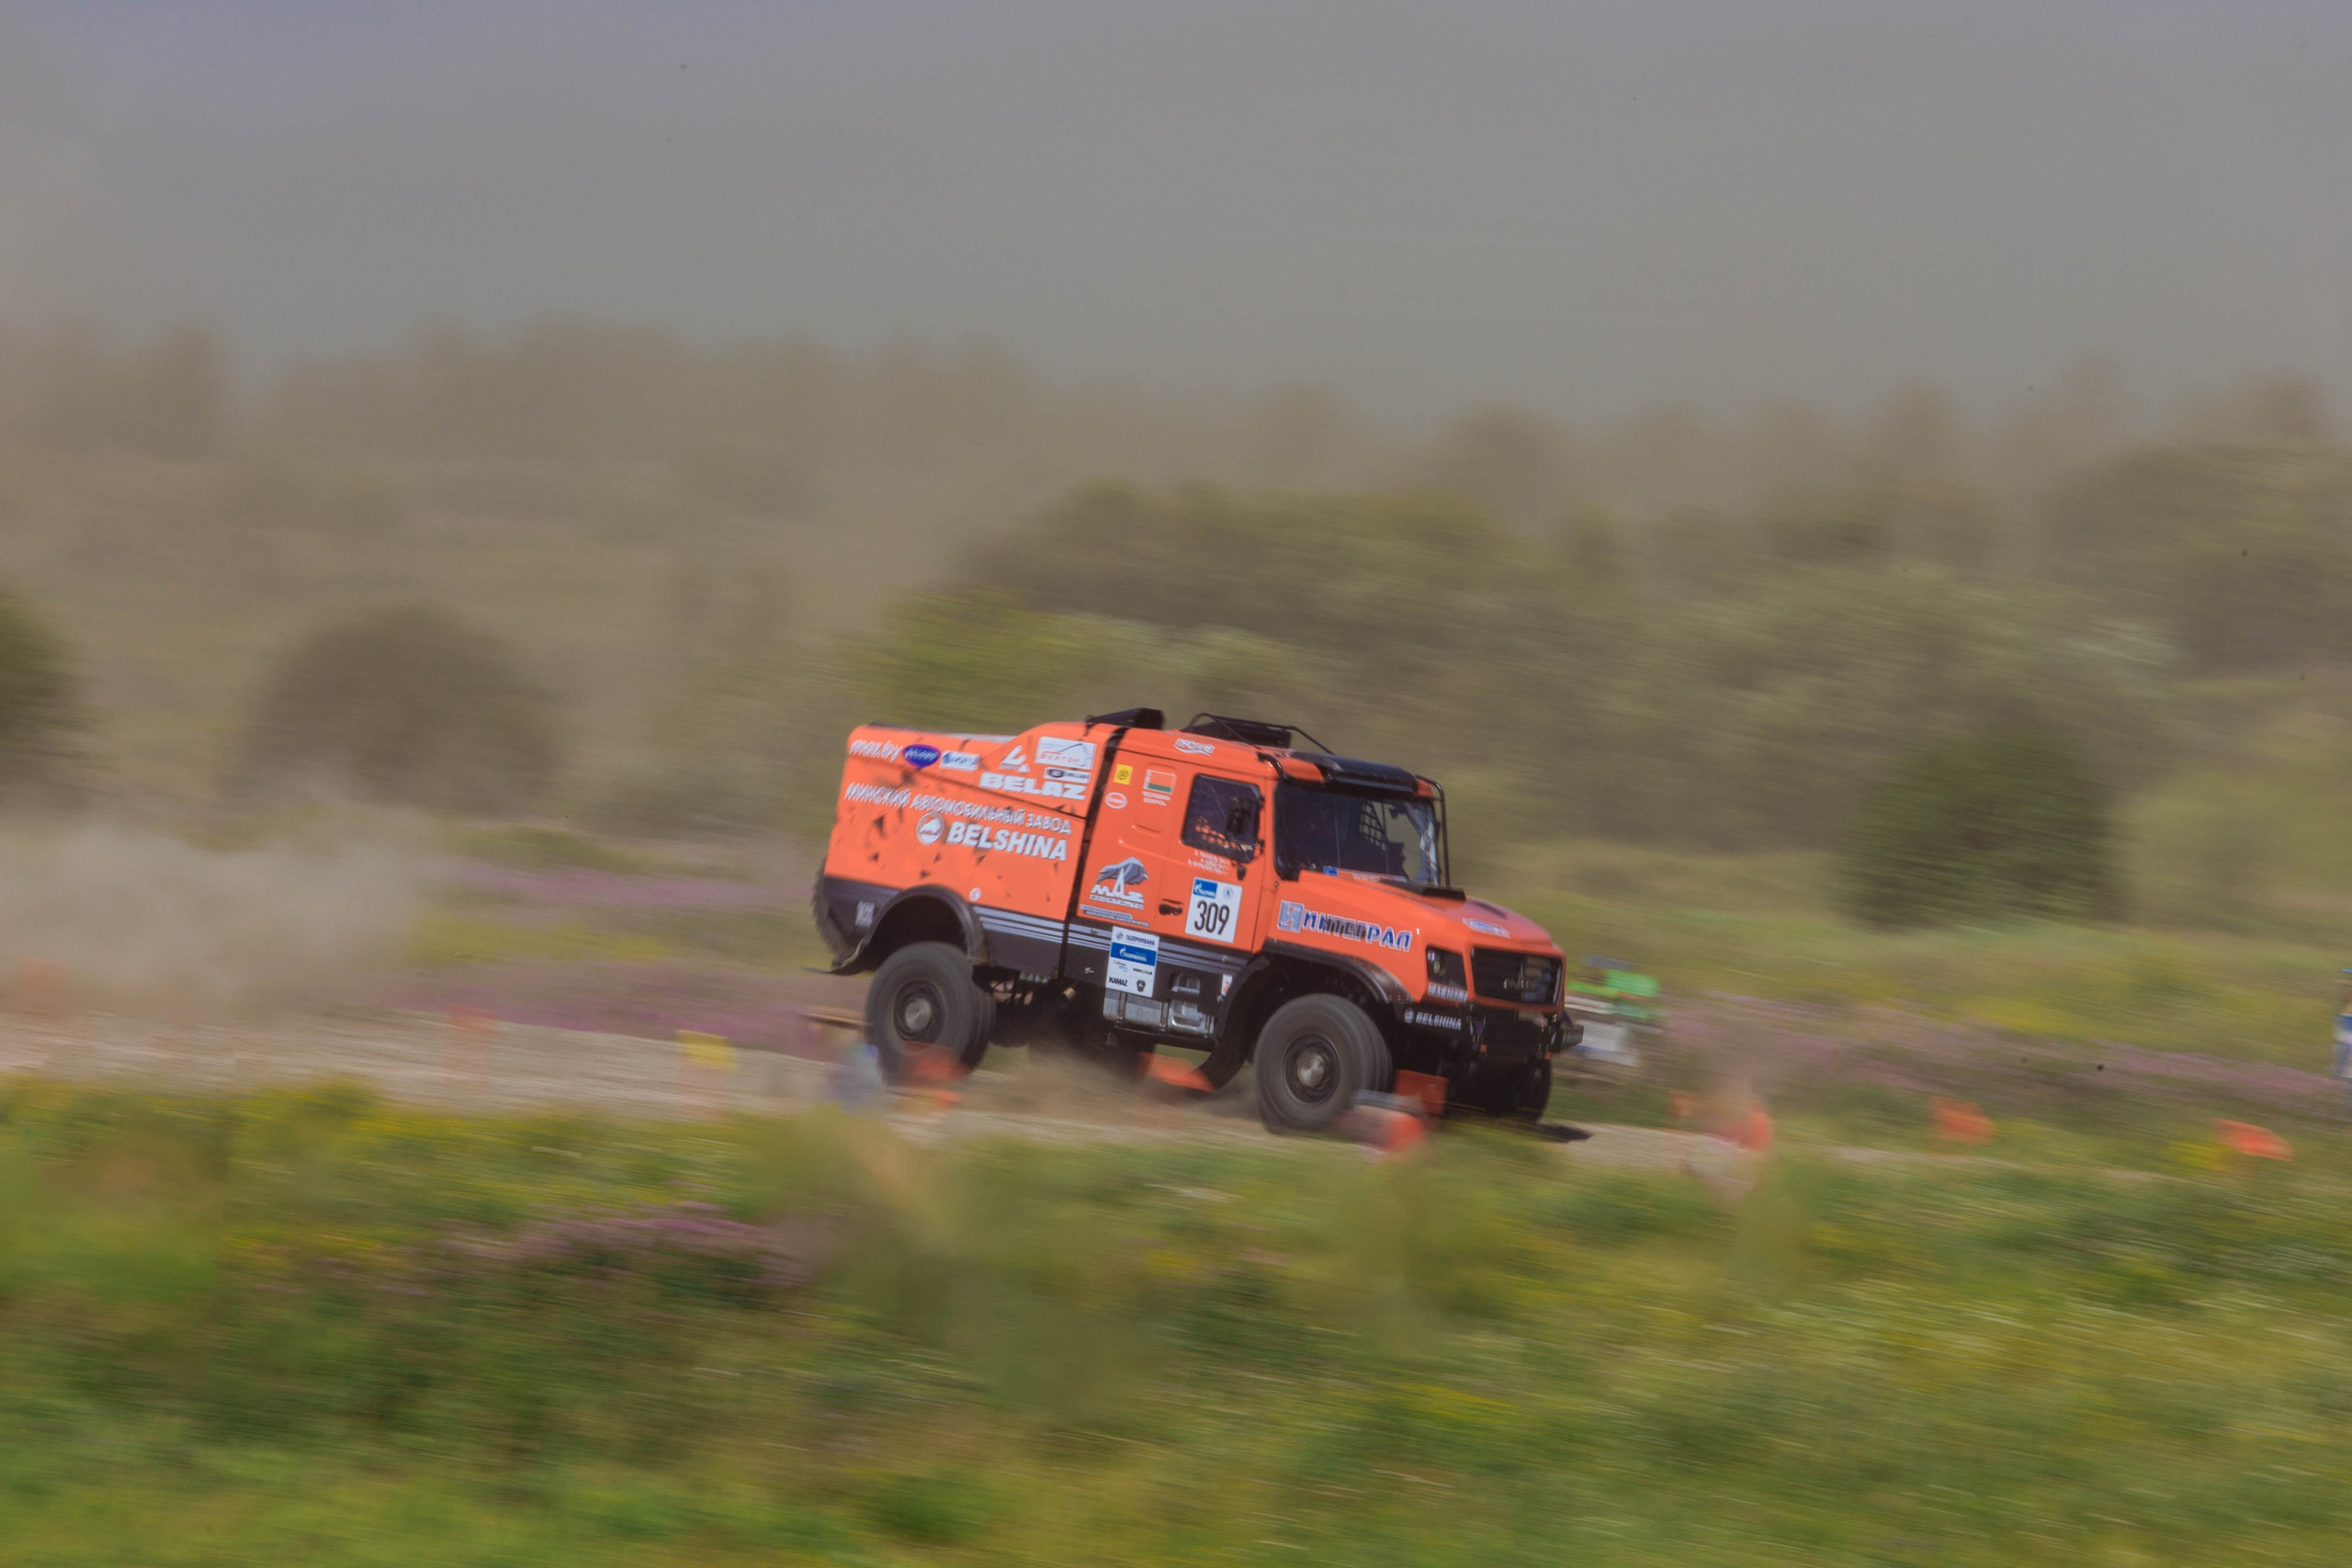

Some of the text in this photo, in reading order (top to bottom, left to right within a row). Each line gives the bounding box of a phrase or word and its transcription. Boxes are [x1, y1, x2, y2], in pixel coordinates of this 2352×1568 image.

[978, 772, 1087, 800] BELAZ
[843, 783, 1071, 836] МИНСКИЙ АВТОМОБИЛЬНЫЙ ЗАВОД
[946, 821, 1068, 862] BELSHINA
[1194, 900, 1230, 935] 309
[1301, 909, 1412, 953] ИНТЕГРАЛ
[1109, 976, 1128, 987] KAMAZ
[1416, 1012, 1462, 1031] BELSHINA
